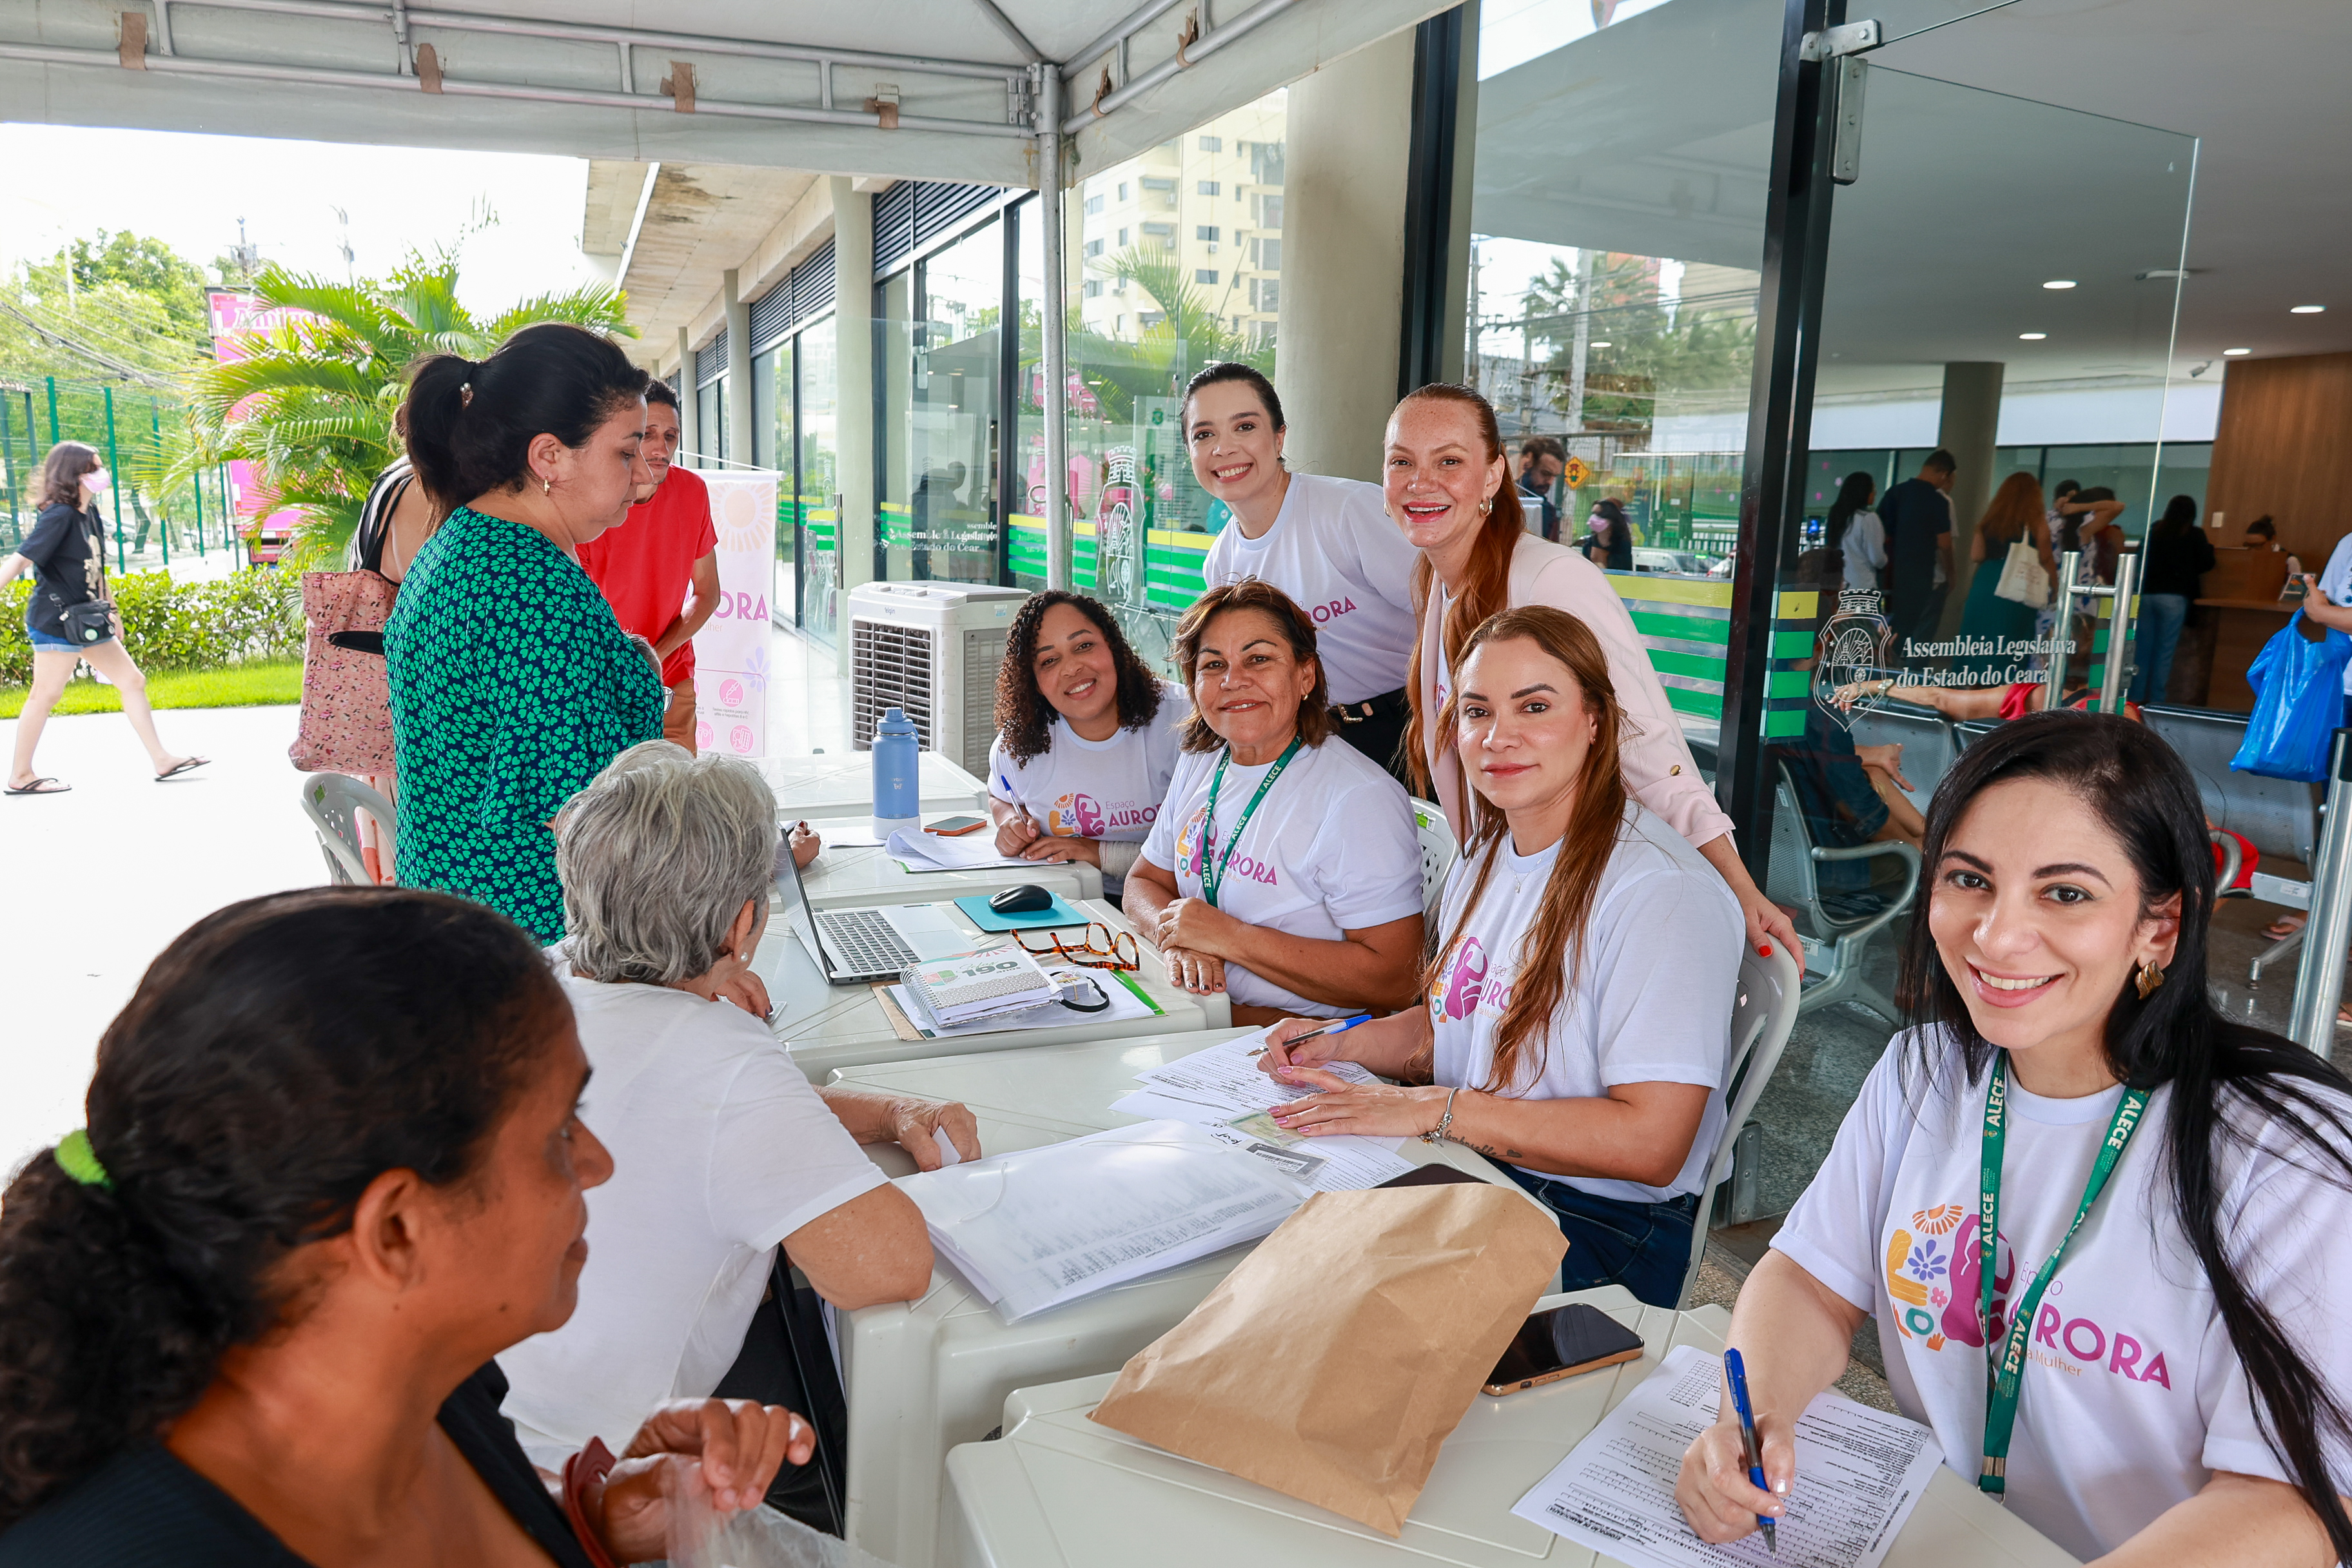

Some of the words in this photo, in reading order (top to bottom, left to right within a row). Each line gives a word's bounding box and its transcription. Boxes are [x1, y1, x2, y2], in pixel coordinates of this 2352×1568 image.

[713, 590, 769, 622] ORA
[1304, 596, 1357, 623] ORA
[701, 622, 723, 632] ulher
[1903, 635, 1994, 657] Assembleia
[1995, 634, 2076, 662] Legislativa
[1896, 667, 1919, 689] do
[1921, 665, 1978, 687] Estado
[1980, 665, 2002, 686] do
[2004, 663, 2049, 685] Ceará
[1262, 764, 1282, 789] ALECE
[1106, 801, 1135, 810] Espaço
[1109, 803, 1162, 827] AURO
[1231, 816, 1248, 840] ALECE
[1202, 861, 1211, 888] ALECE
[1227, 872, 1242, 883] Mulher
[962, 961, 1018, 977] 190
[1489, 963, 1507, 977] aço
[1480, 977, 1512, 1011] URO
[1986, 1077, 2004, 1127] ALECE
[2107, 1095, 2142, 1150] ALECE
[1982, 1192, 1994, 1246] ALECE
[2004, 1318, 2026, 1375] ALECE
[2035, 1350, 2082, 1377] Mulher
